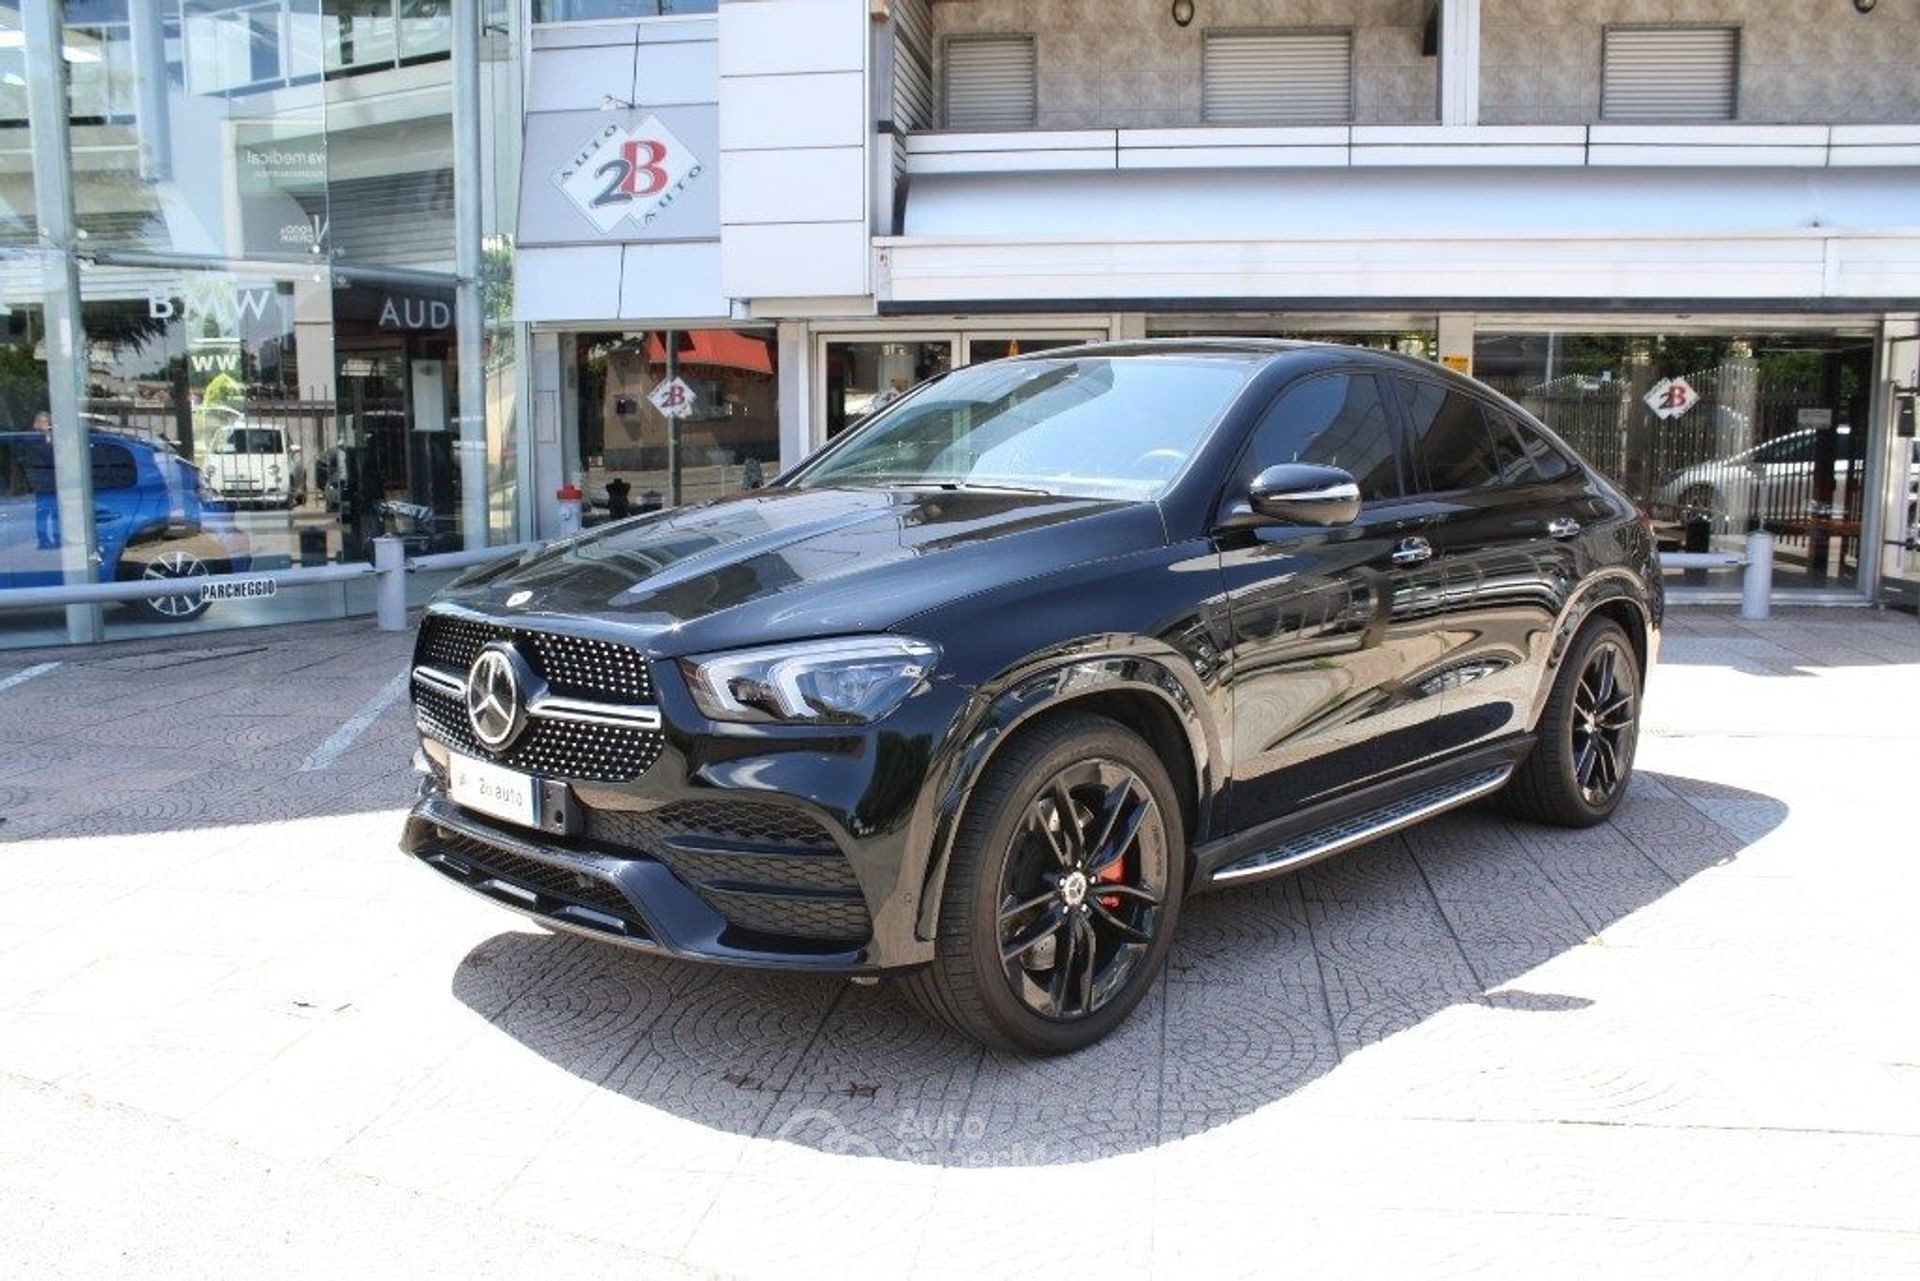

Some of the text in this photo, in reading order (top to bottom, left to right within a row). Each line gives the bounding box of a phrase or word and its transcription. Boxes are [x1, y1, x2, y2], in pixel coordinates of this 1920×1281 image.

[560, 124, 617, 185] AUTO
[645, 165, 702, 225] AUTO
[149, 289, 271, 323] BMW
[202, 579, 275, 599] PARCHEGGIO
